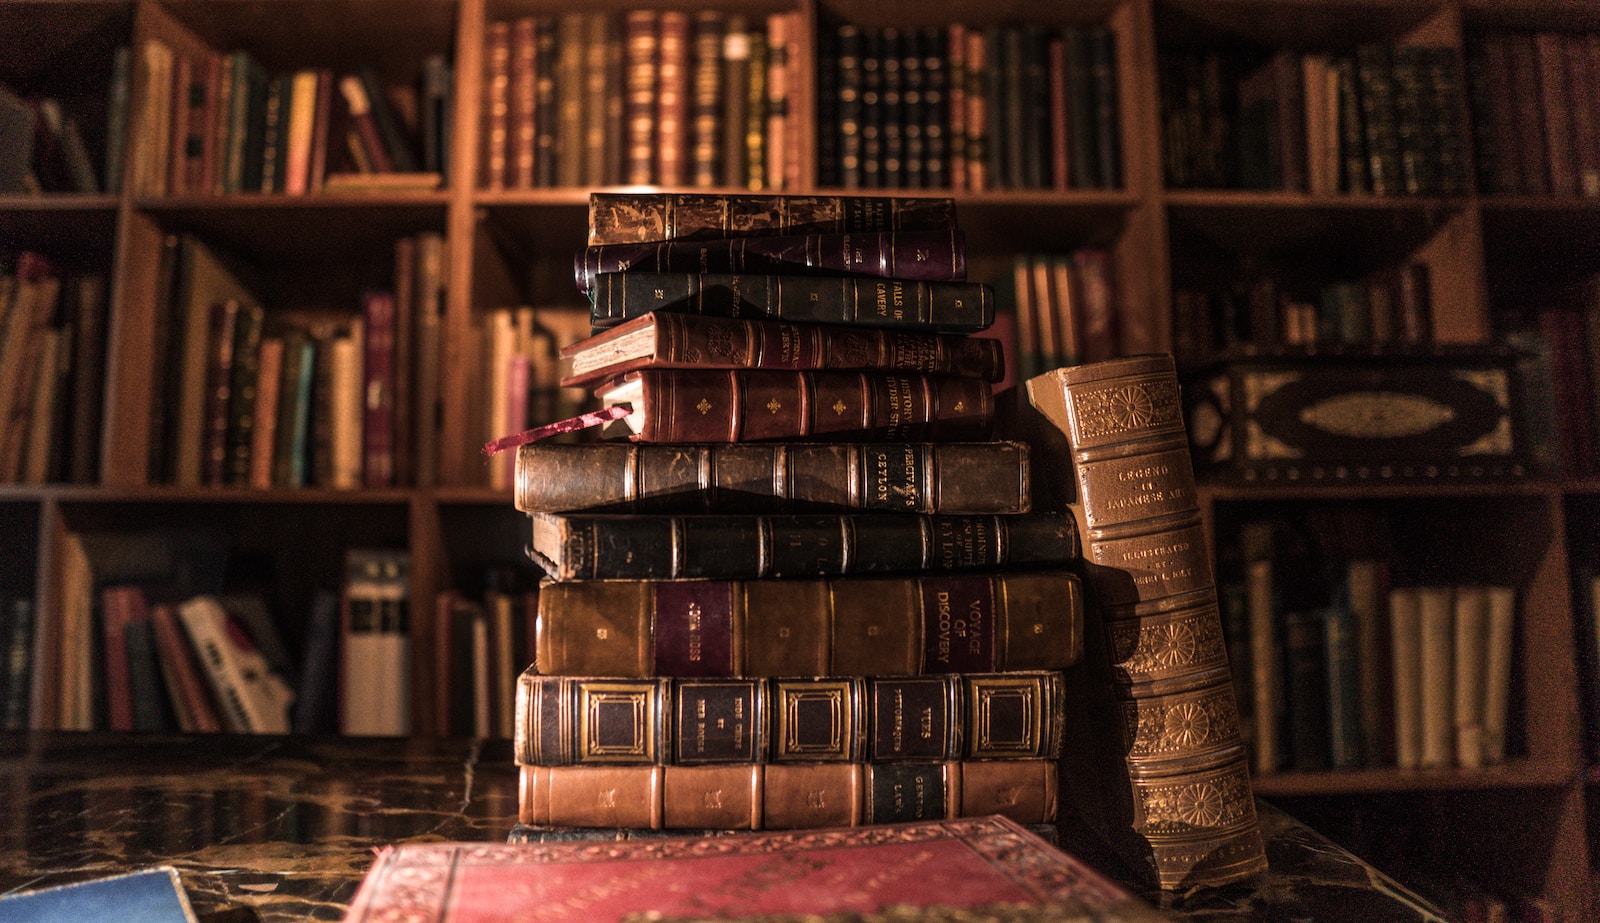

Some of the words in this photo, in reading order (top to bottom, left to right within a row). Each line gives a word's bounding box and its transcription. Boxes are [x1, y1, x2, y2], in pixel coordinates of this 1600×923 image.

[876, 282, 887, 317] CAVERY
[893, 281, 903, 307] FALLS
[893, 309, 903, 321] OF
[886, 376, 899, 409] HYDER
[900, 378, 913, 422] HISTORY
[877, 453, 888, 502] CEYLON
[1118, 465, 1169, 482] LEGEND
[1107, 491, 1164, 510] JAPANESE
[937, 592, 951, 664] DISCOVERY
[953, 619, 967, 638] OF
[968, 600, 981, 655] VOYAGE
[920, 706, 932, 739] VUES
[894, 784, 903, 814] LAWS
[915, 776, 924, 819] GENTOO
